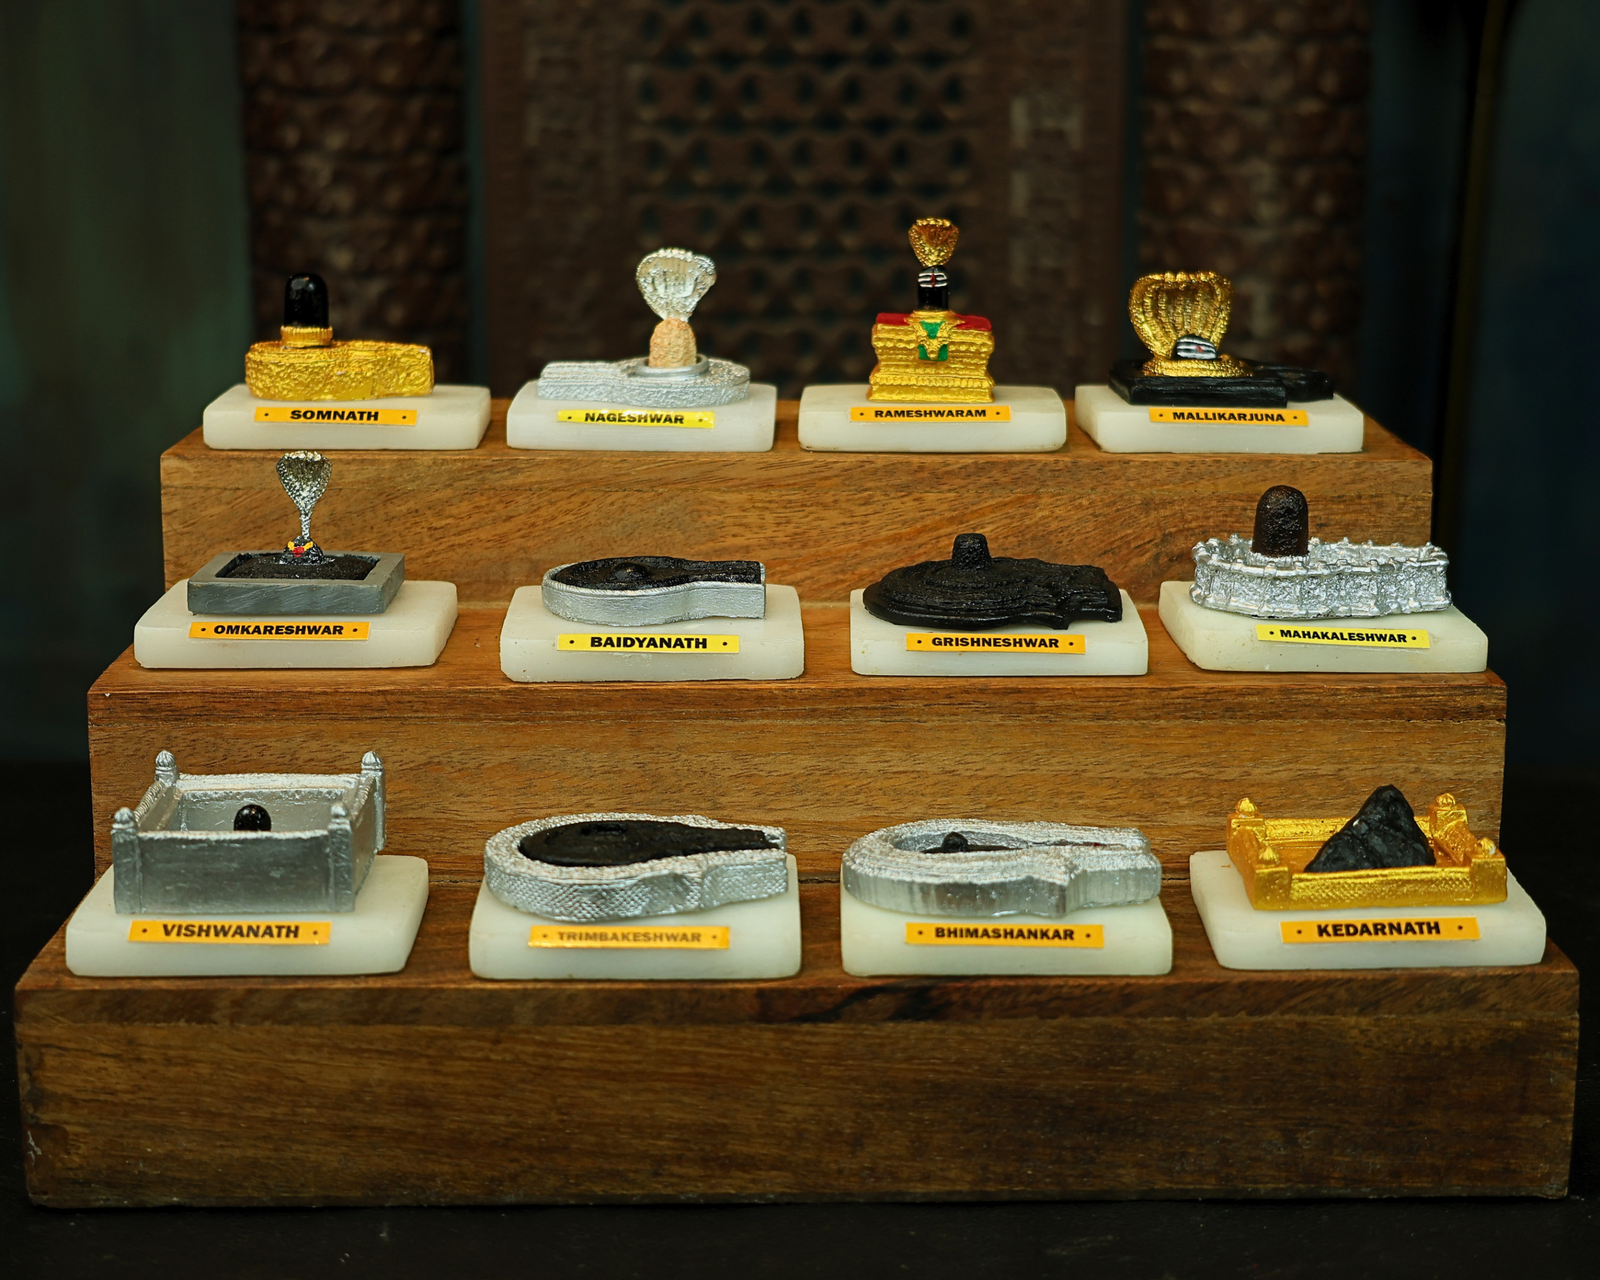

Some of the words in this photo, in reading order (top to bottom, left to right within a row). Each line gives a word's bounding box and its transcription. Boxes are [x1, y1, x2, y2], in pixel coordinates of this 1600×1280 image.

[290, 409, 379, 421] SOMNATH
[584, 412, 684, 425] NAGESHWAR
[874, 409, 987, 418] RAMESHWARAM
[1172, 411, 1286, 422] MALLIKARJUNA
[213, 624, 344, 635] OMKARESHWAR
[1279, 629, 1408, 643] MAHAKALESHWAR
[590, 636, 708, 649] BAIDYANATH
[931, 637, 1059, 648] GRISHNESHWAR
[162, 923, 300, 939] VISHWANATH
[935, 927, 1075, 941] BHIMASHANKAR
[1317, 921, 1441, 937] KEDARNATH
[558, 931, 702, 943] TRIMBAKESHWAR
